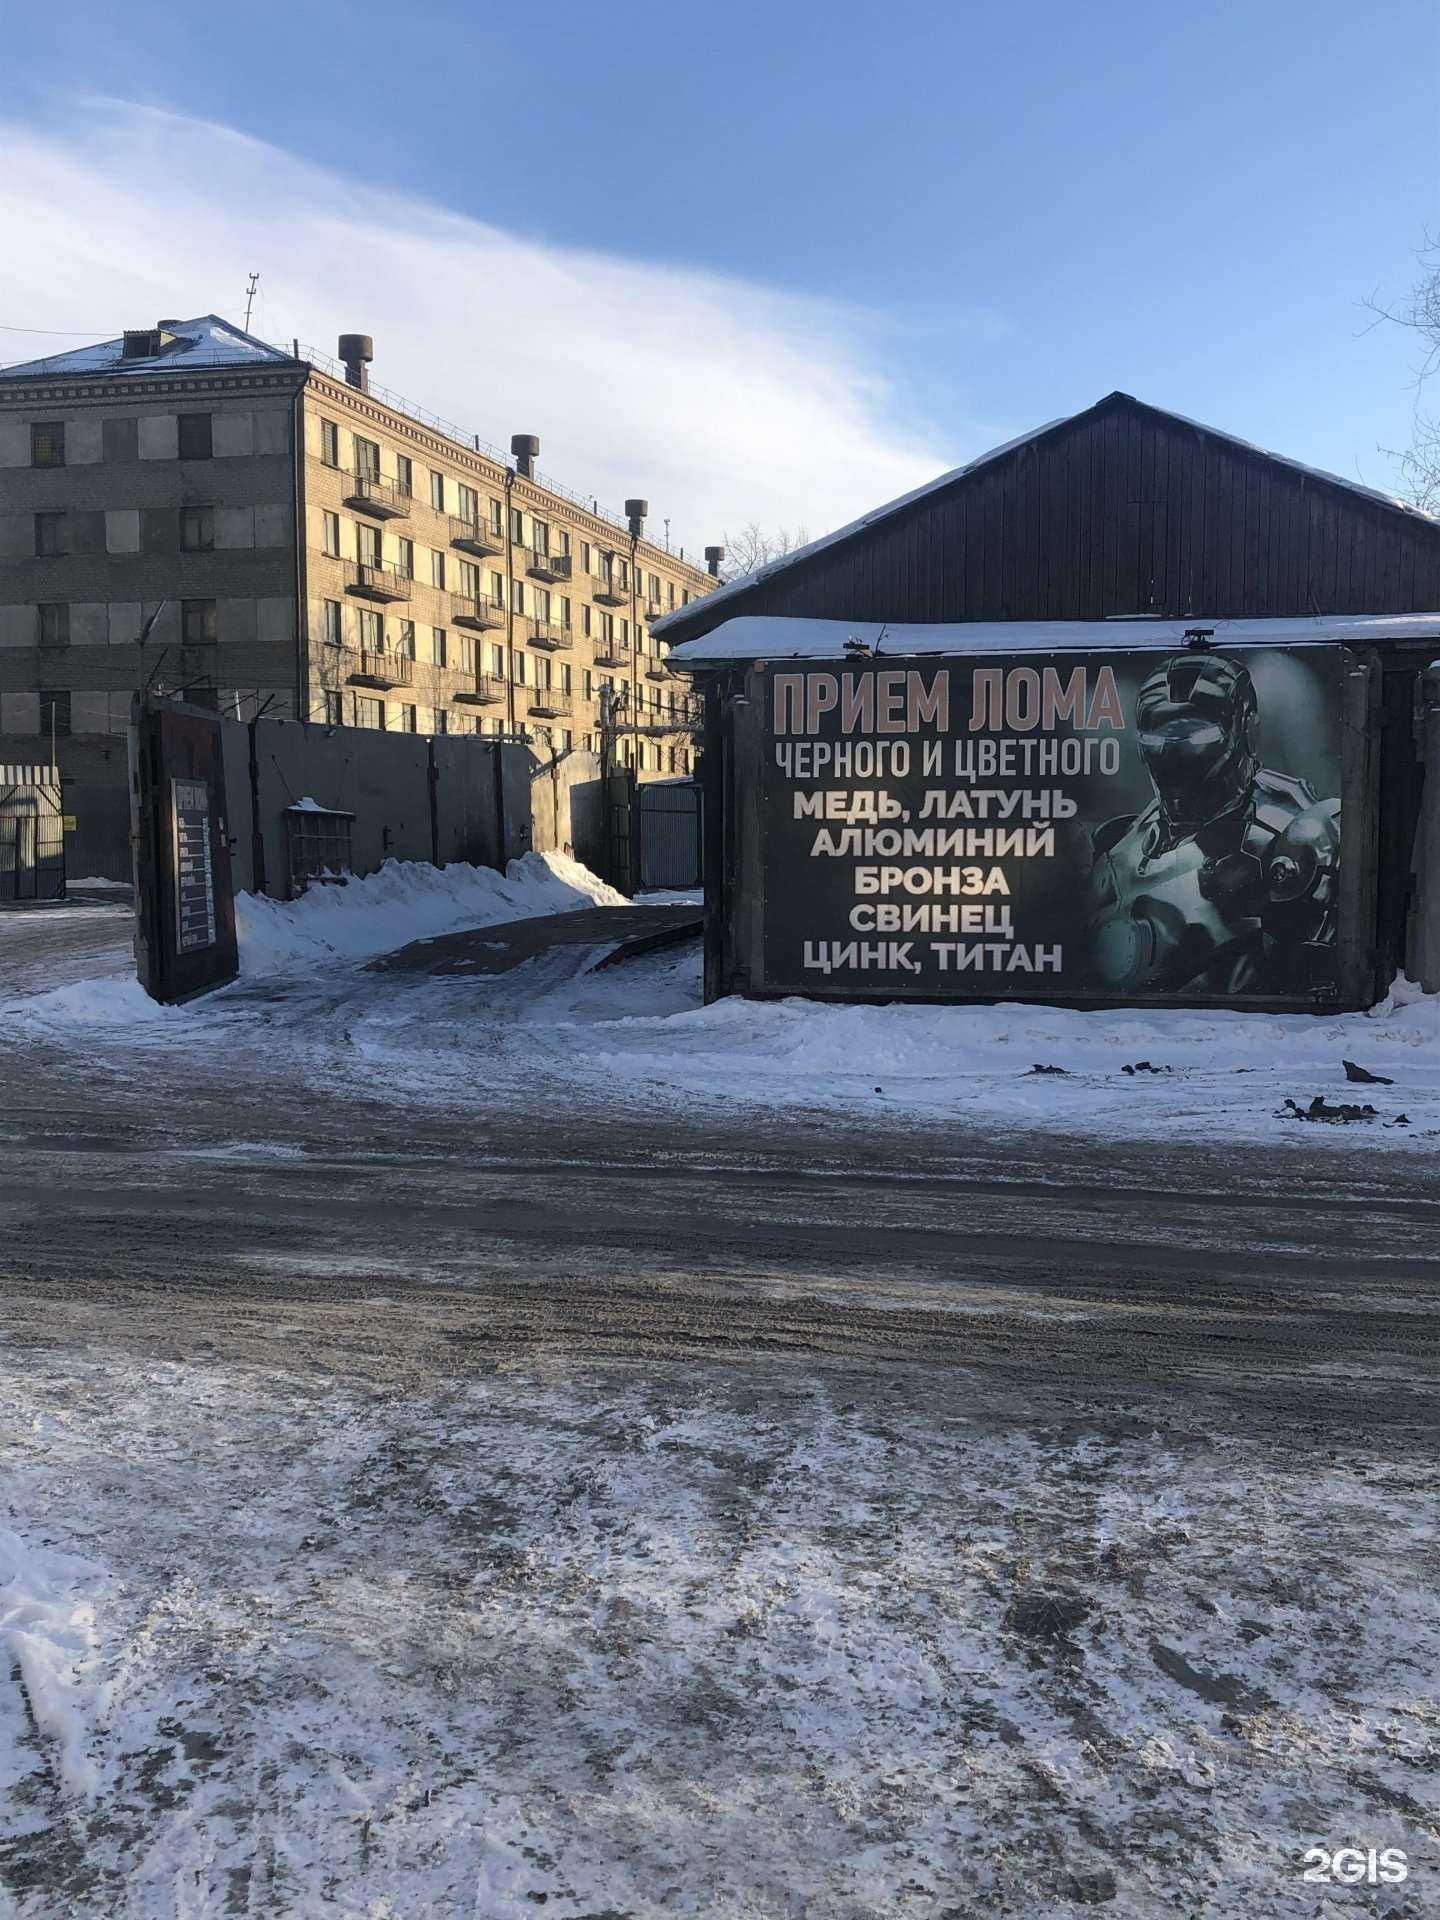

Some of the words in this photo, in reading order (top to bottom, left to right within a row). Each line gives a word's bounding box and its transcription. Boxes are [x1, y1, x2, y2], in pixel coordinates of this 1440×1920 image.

[773, 670, 949, 735] ПРИЕМ
[968, 666, 1125, 732] ЛОМА
[775, 740, 910, 778] ЧЕРНОГО
[923, 740, 942, 776] И
[955, 738, 1120, 783] ЦВЕТНОГО
[793, 790, 910, 824] МЕДЬ,
[919, 789, 1078, 819] ЛАТУНЬ
[810, 821, 1055, 857] АЛЮМИНИЙ
[854, 866, 1010, 896] БРОНЗА
[849, 904, 1014, 939] СВИНЕЦ
[803, 941, 922, 975] ЦИНК,
[930, 943, 1063, 973] ТИТАН
